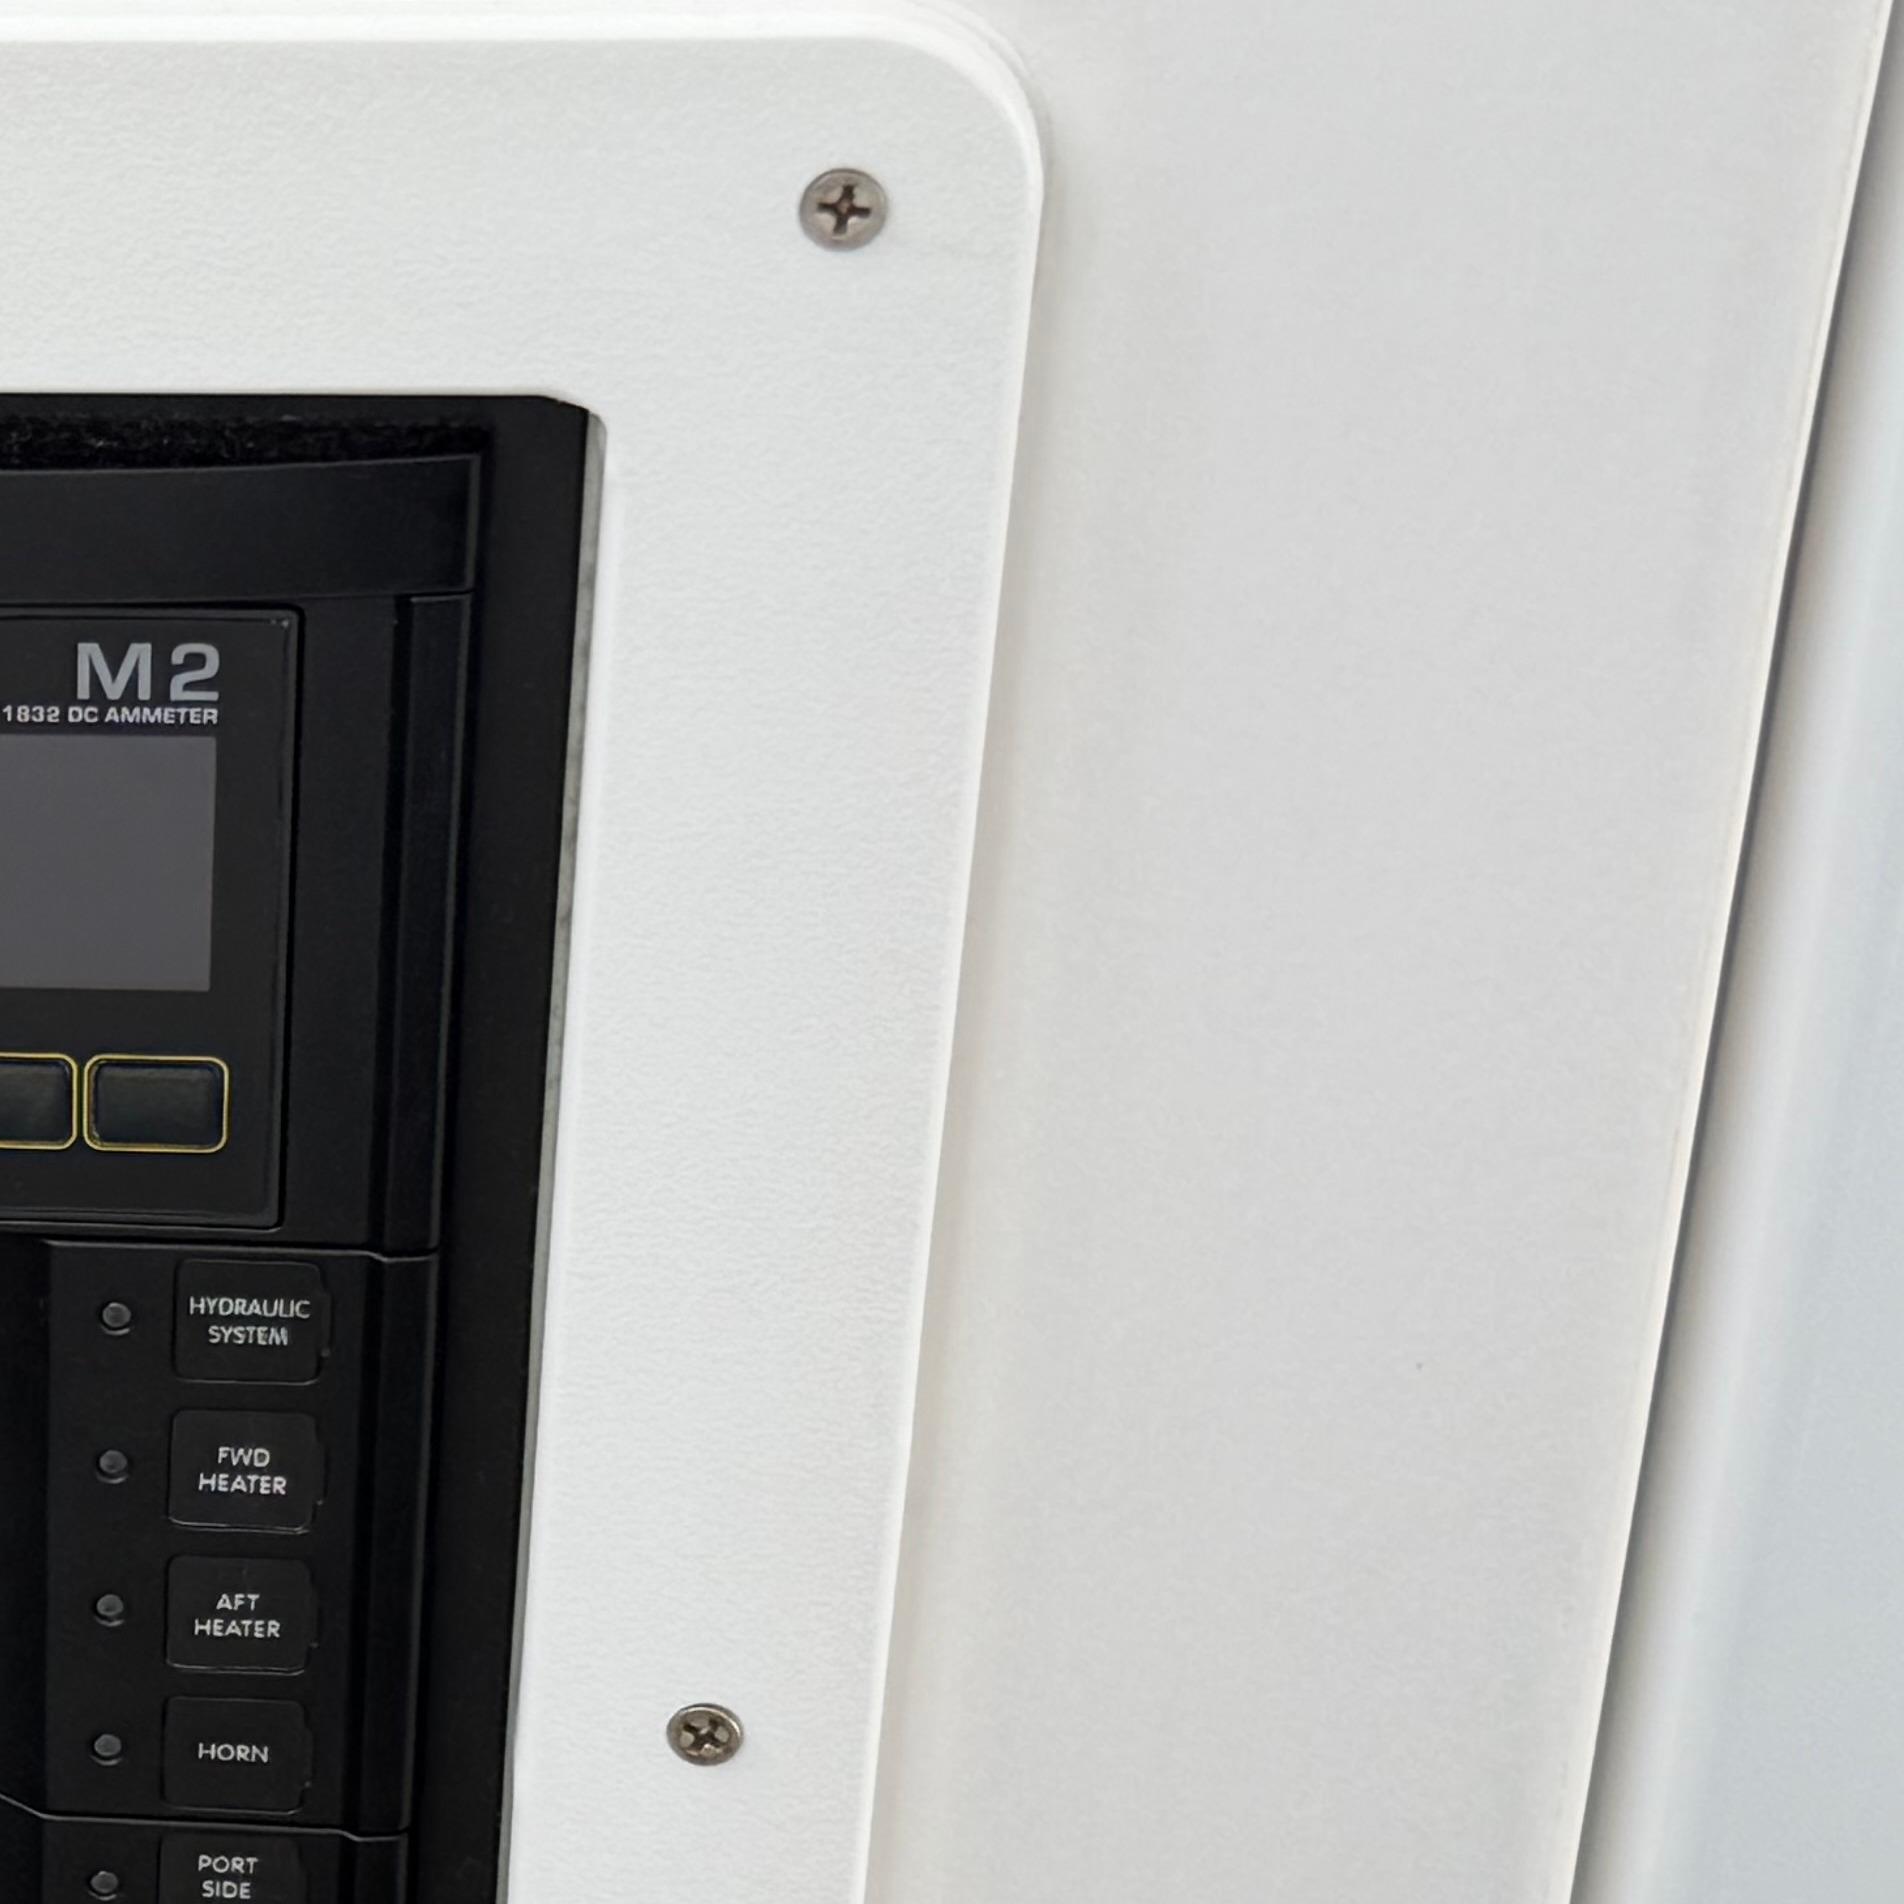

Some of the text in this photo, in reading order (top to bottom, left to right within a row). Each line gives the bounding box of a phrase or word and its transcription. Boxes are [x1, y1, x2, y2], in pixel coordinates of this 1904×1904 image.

[77, 643, 219, 701] M2
[3, 705, 218, 724] 1832 DC AMMETER
[190, 1297, 310, 1318] HYDRAULIC
[208, 1325, 288, 1345] SYSTEM
[218, 1447, 270, 1467] FWD
[199, 1473, 286, 1495] HEATER
[216, 1594, 259, 1610] AFT
[195, 1619, 280, 1638] HEATER
[198, 1743, 268, 1762] HORN
[198, 1855, 258, 1873] PORT
[202, 1880, 250, 1899] SIDE
